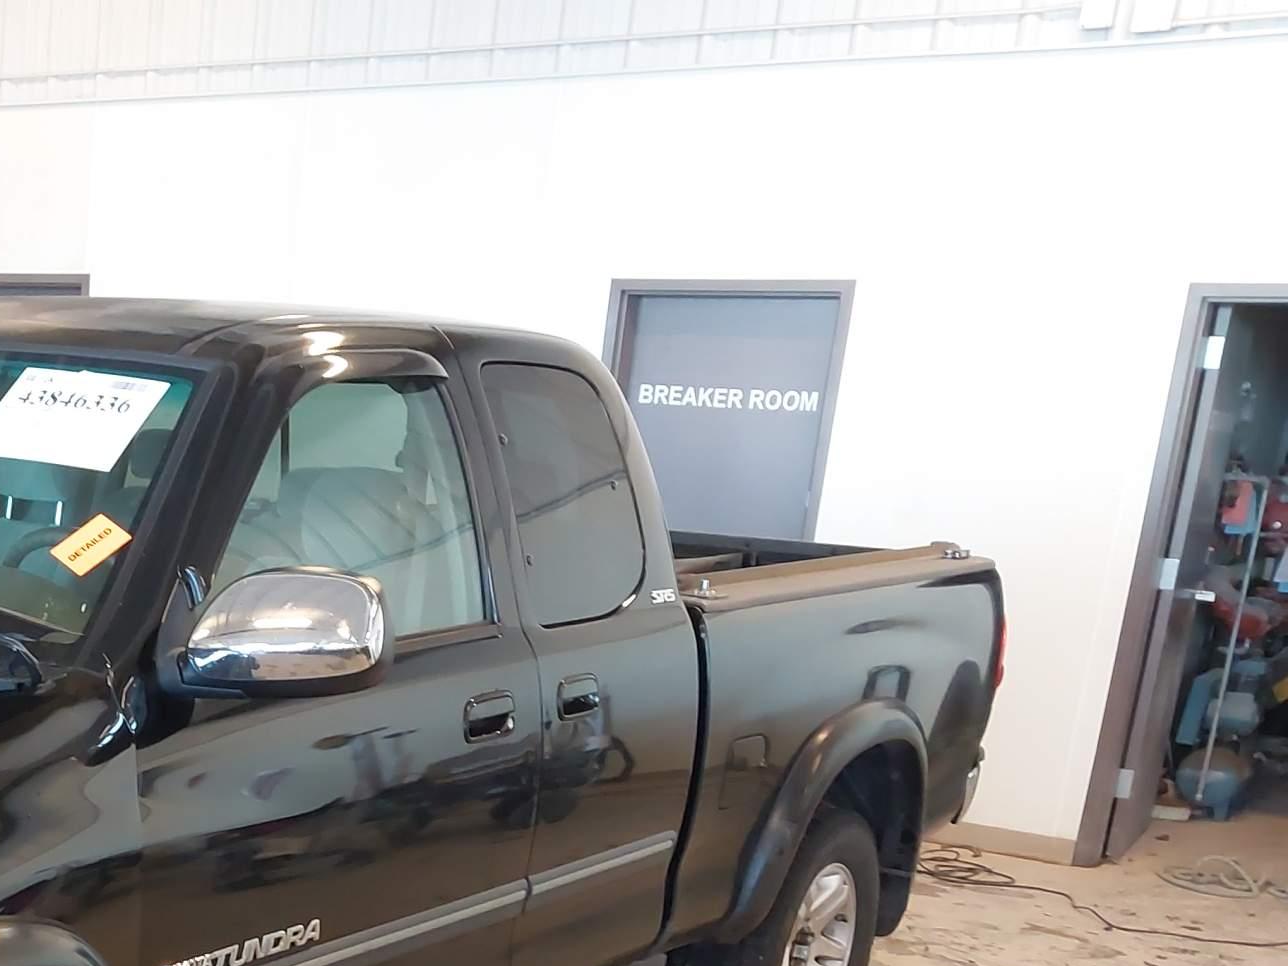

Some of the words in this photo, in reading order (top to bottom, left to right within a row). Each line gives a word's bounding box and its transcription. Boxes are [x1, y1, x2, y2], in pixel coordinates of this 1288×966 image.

[18, 389, 131, 414] 43846336
[638, 383, 744, 409] BREAKER
[748, 388, 819, 412] ROOM
[67, 527, 113, 562] DETAILED
